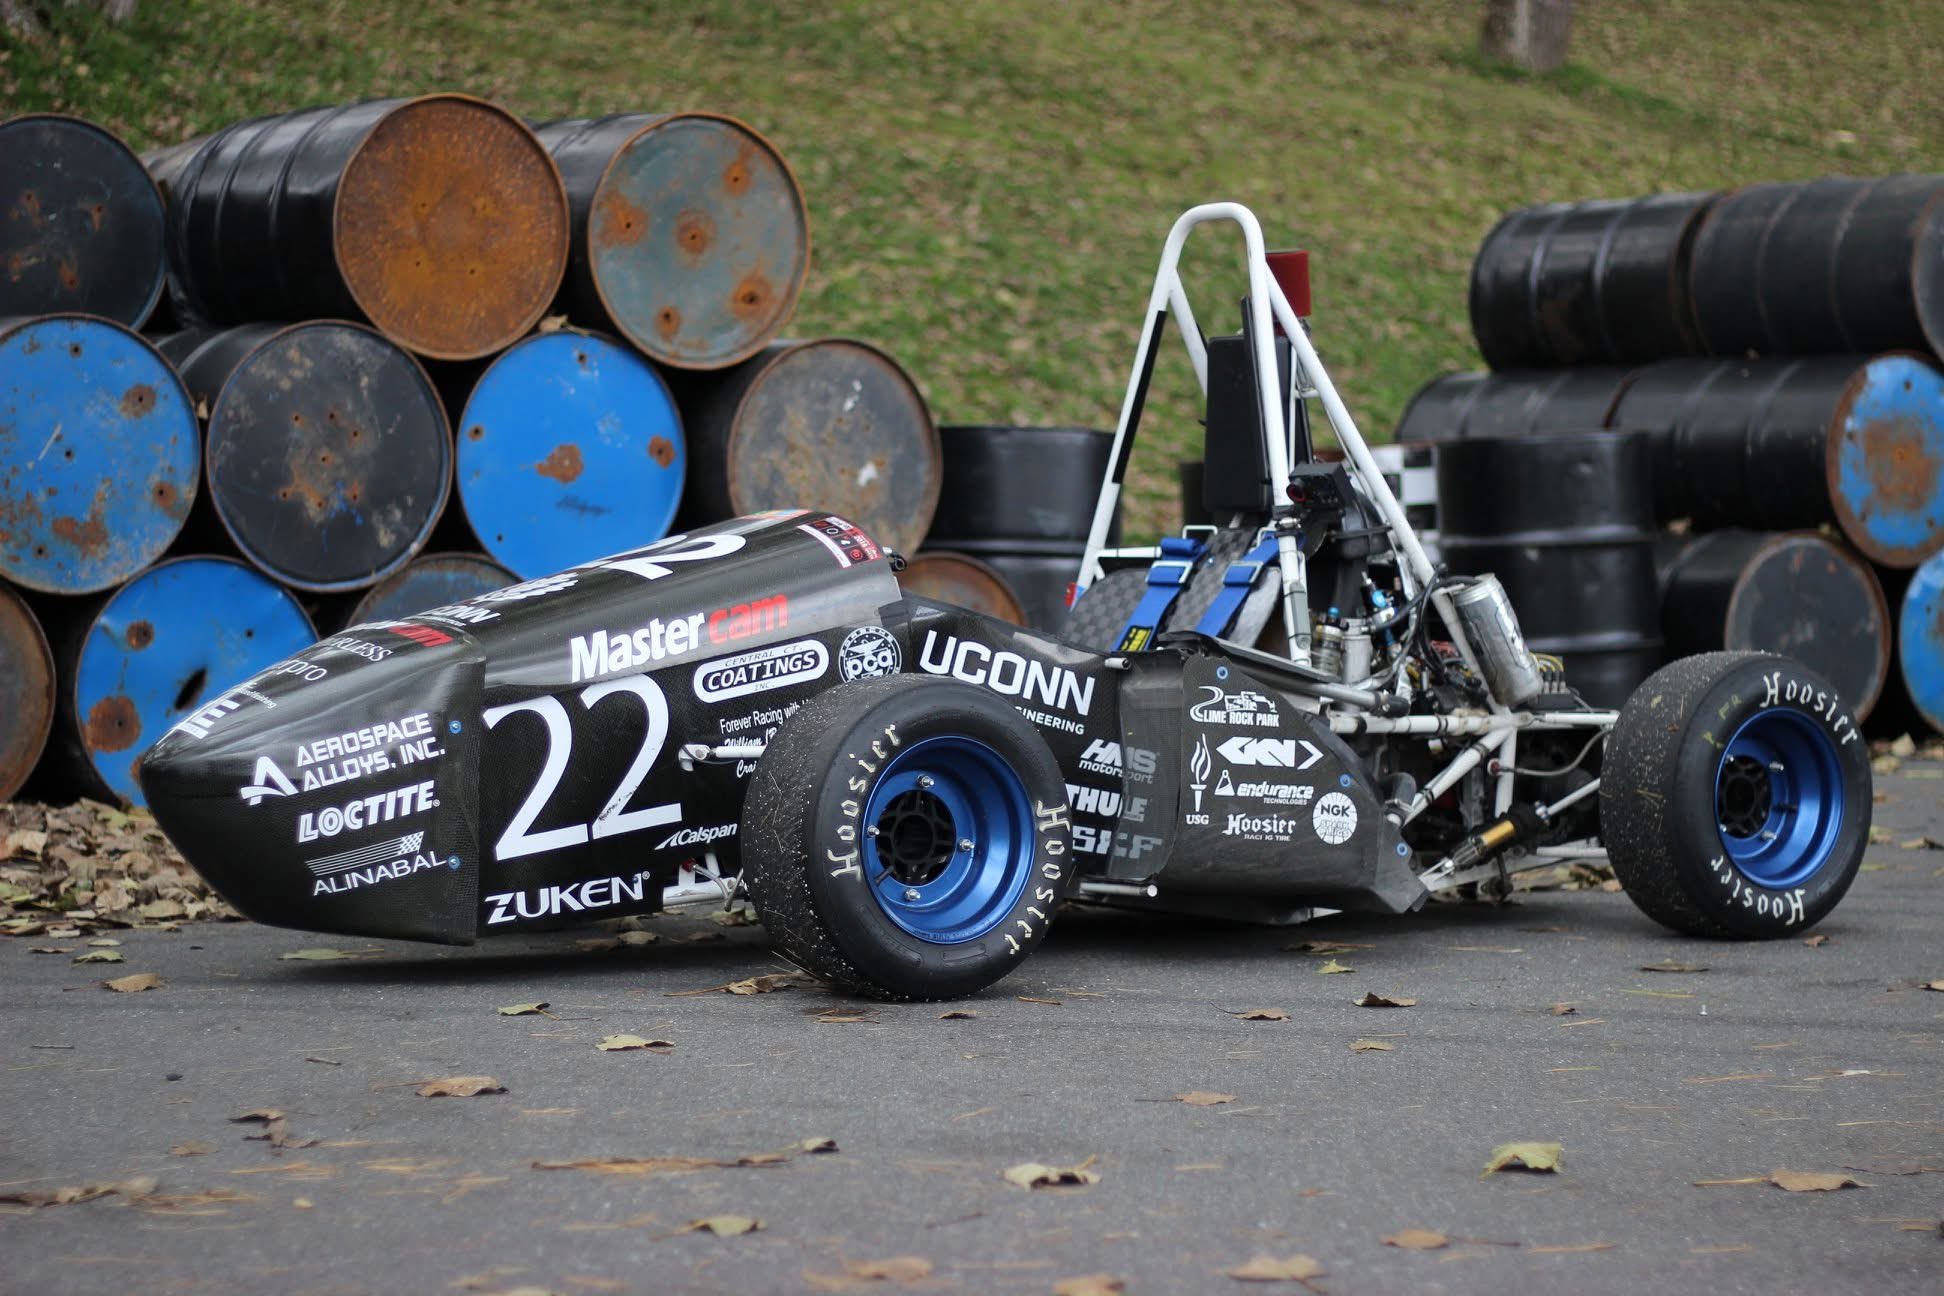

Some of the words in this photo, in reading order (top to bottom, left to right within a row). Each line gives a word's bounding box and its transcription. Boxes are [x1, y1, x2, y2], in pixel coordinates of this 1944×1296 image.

[570, 593, 789, 683] Mastercam
[724, 651, 775, 667] CENTRAL
[708, 650, 816, 690] COATINGS
[919, 629, 1096, 717] UCONN
[720, 715, 752, 734] Forever
[753, 707, 783, 727] Racing
[1015, 706, 1085, 735] INEERING
[1203, 709, 1226, 724] LIME
[1229, 711, 1254, 726] ROCK
[1256, 712, 1280, 727] PARK
[1759, 671, 1858, 745] Hoosier
[297, 712, 433, 767] AEROSPACE
[400, 736, 446, 765] INC.
[483, 674, 682, 861] 22
[298, 780, 436, 843] LOCTITE
[827, 724, 900, 881] Hoosier
[1236, 781, 1314, 800] endurance
[1320, 803, 1350, 818] NGK
[678, 823, 738, 844] Calspan
[1186, 814, 1210, 825] USG
[1222, 813, 1297, 836] Hoosier
[313, 851, 447, 896] ALINABAL
[1004, 799, 1071, 955] Hoosier
[1711, 856, 1806, 926] Hoosier
[485, 876, 643, 924] ZUKEN
